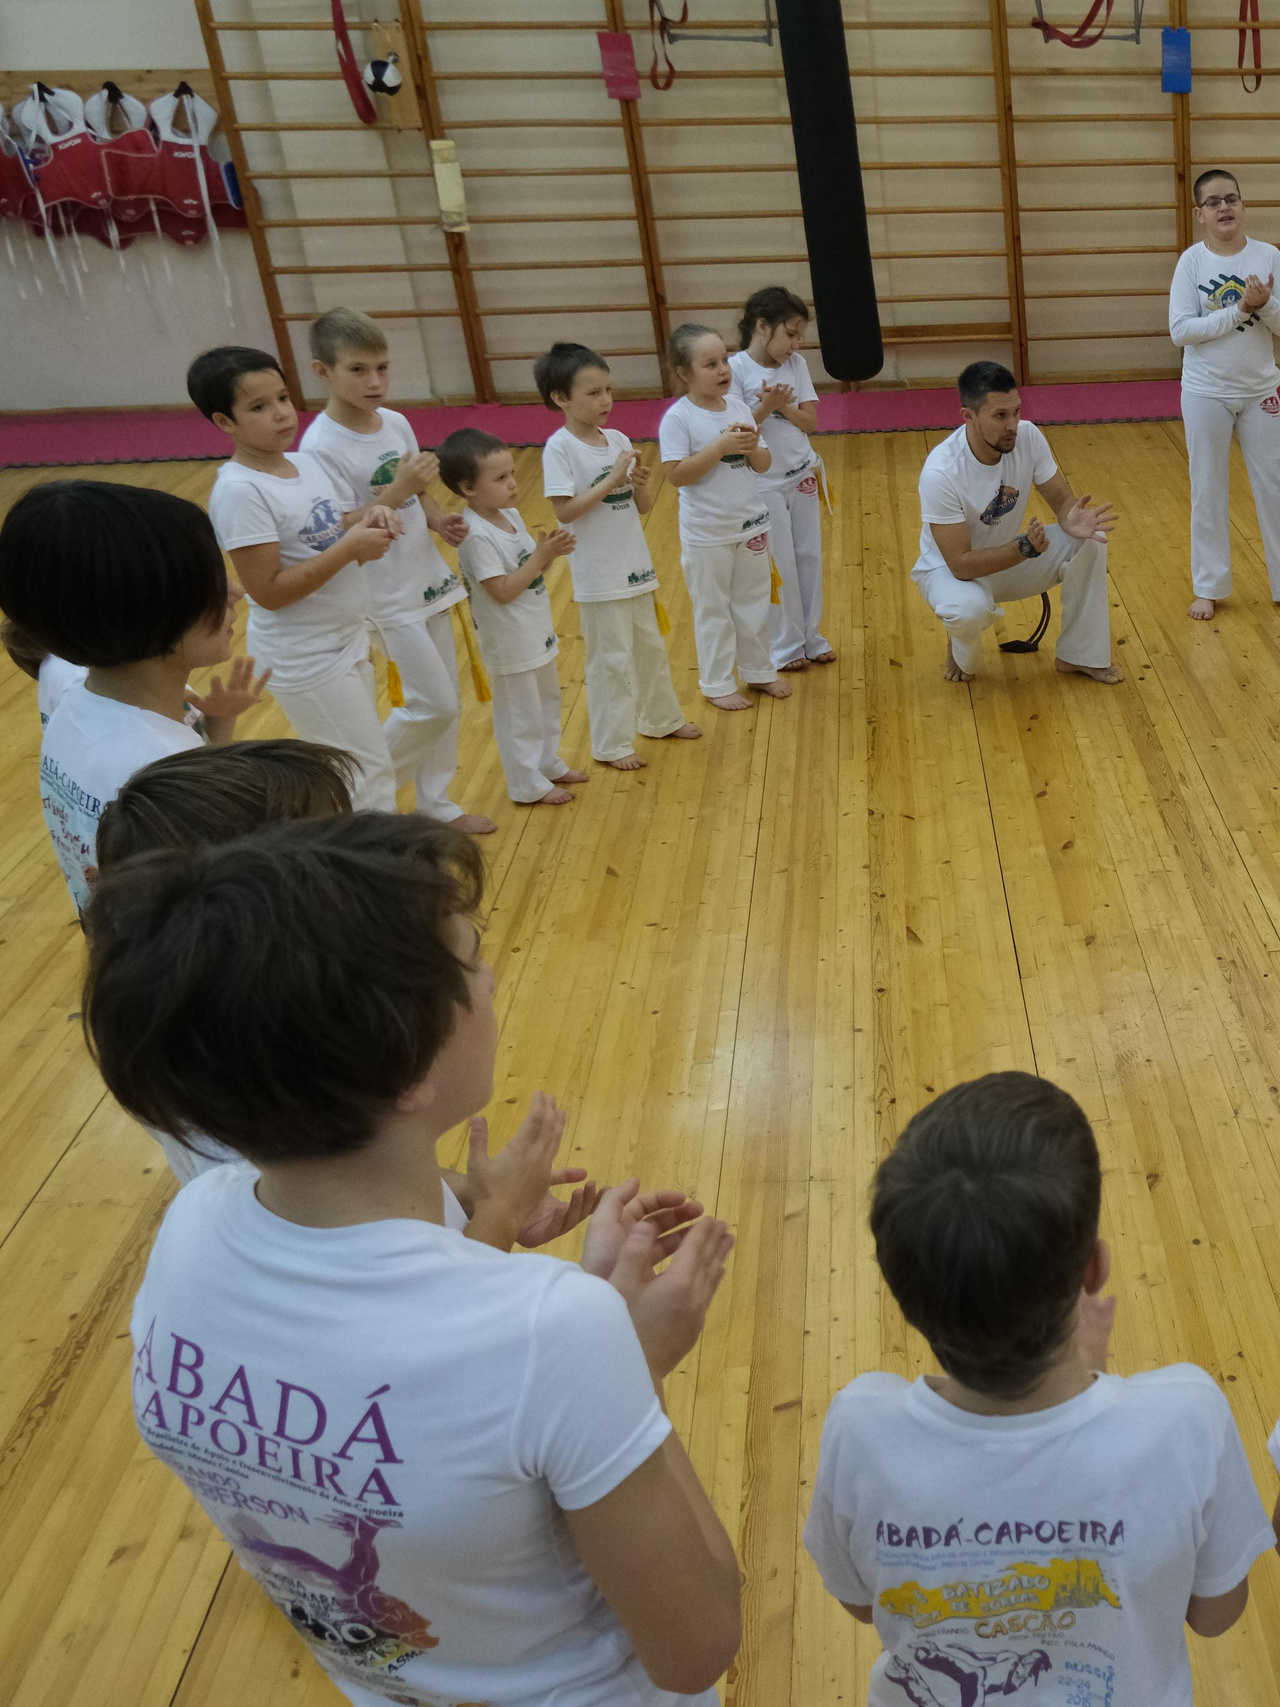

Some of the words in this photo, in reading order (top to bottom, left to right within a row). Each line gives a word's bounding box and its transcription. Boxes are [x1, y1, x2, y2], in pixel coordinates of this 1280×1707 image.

[58, 137, 81, 150] KWON
[173, 151, 196, 159] KWO
[137, 1315, 404, 1464] ABADÁ
[876, 1517, 1125, 1550] ABADÁ-CAPOEIRA
[942, 1575, 1050, 1600] BATIZADO
[951, 1601, 970, 1612] DE
[974, 1611, 1077, 1639] CASCÃO
